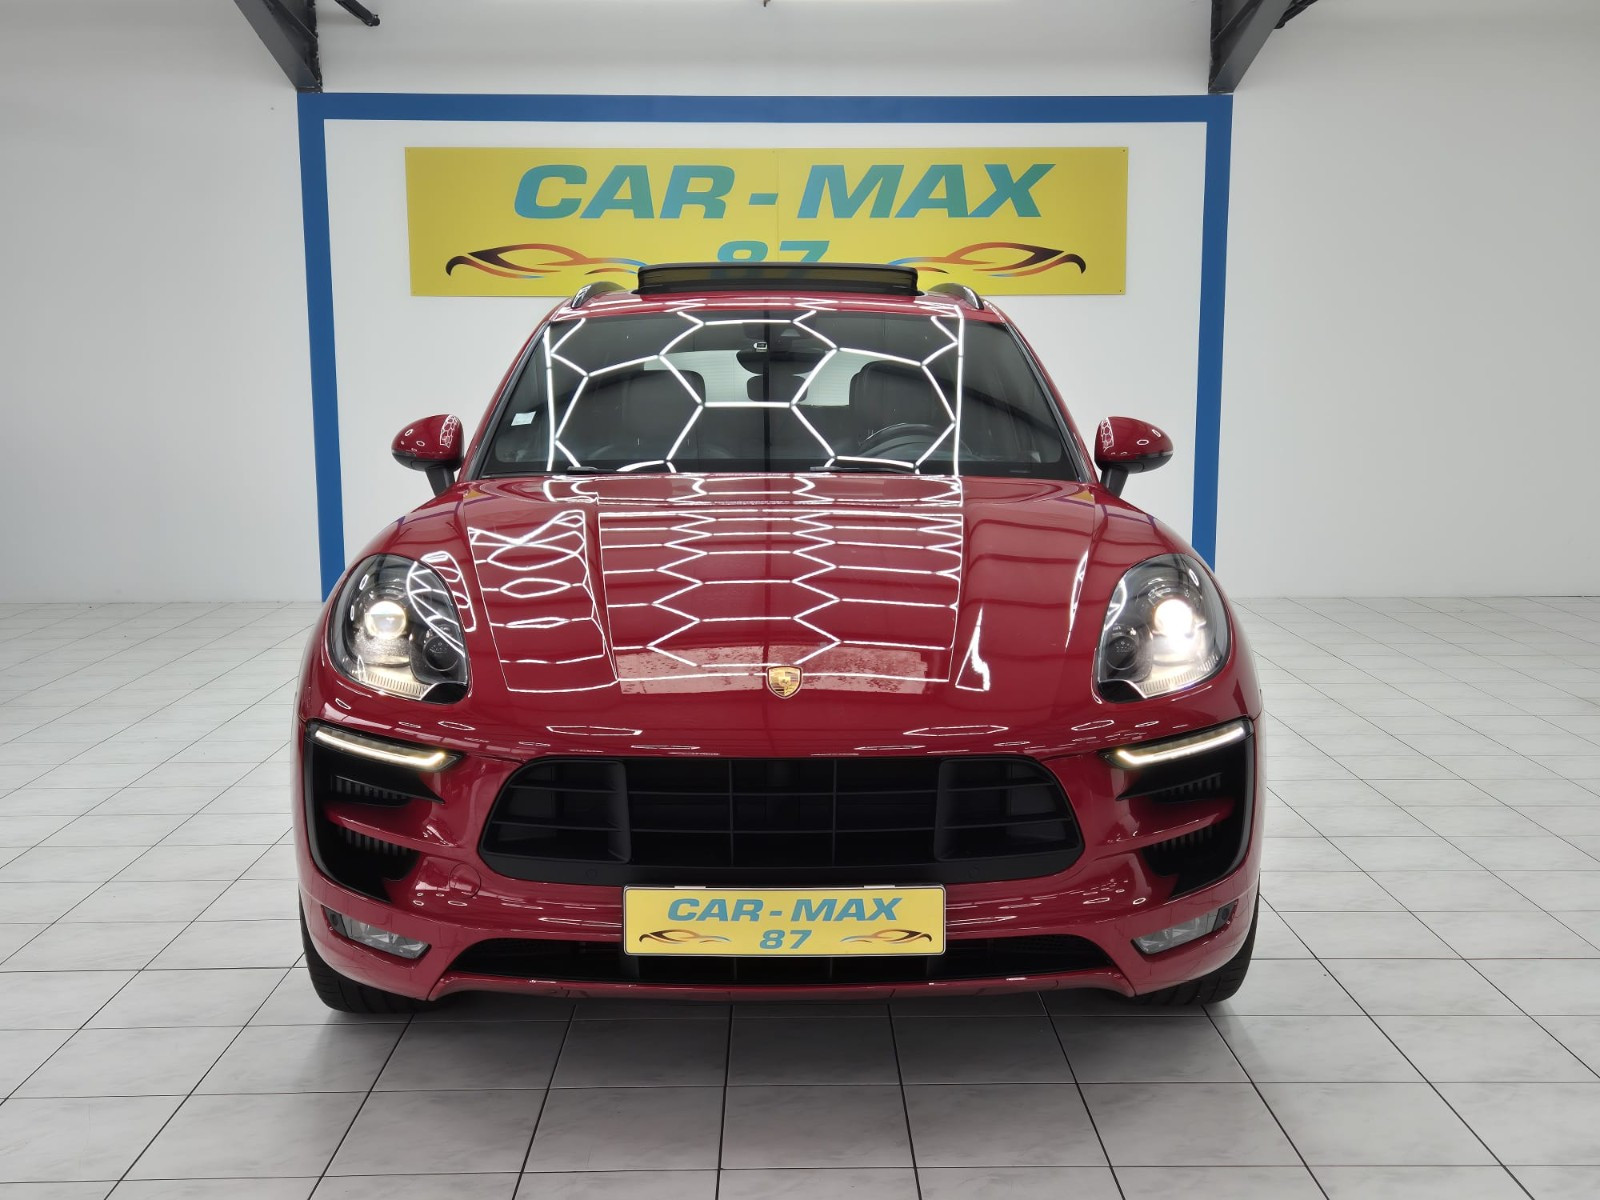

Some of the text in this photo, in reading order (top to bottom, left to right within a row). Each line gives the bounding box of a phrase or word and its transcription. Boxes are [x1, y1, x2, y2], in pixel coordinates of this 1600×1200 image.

[514, 164, 735, 219] CAR
[797, 164, 1055, 219] MAX
[667, 898, 764, 922] CAR
[790, 897, 903, 921] MAX
[759, 929, 812, 950] 87
